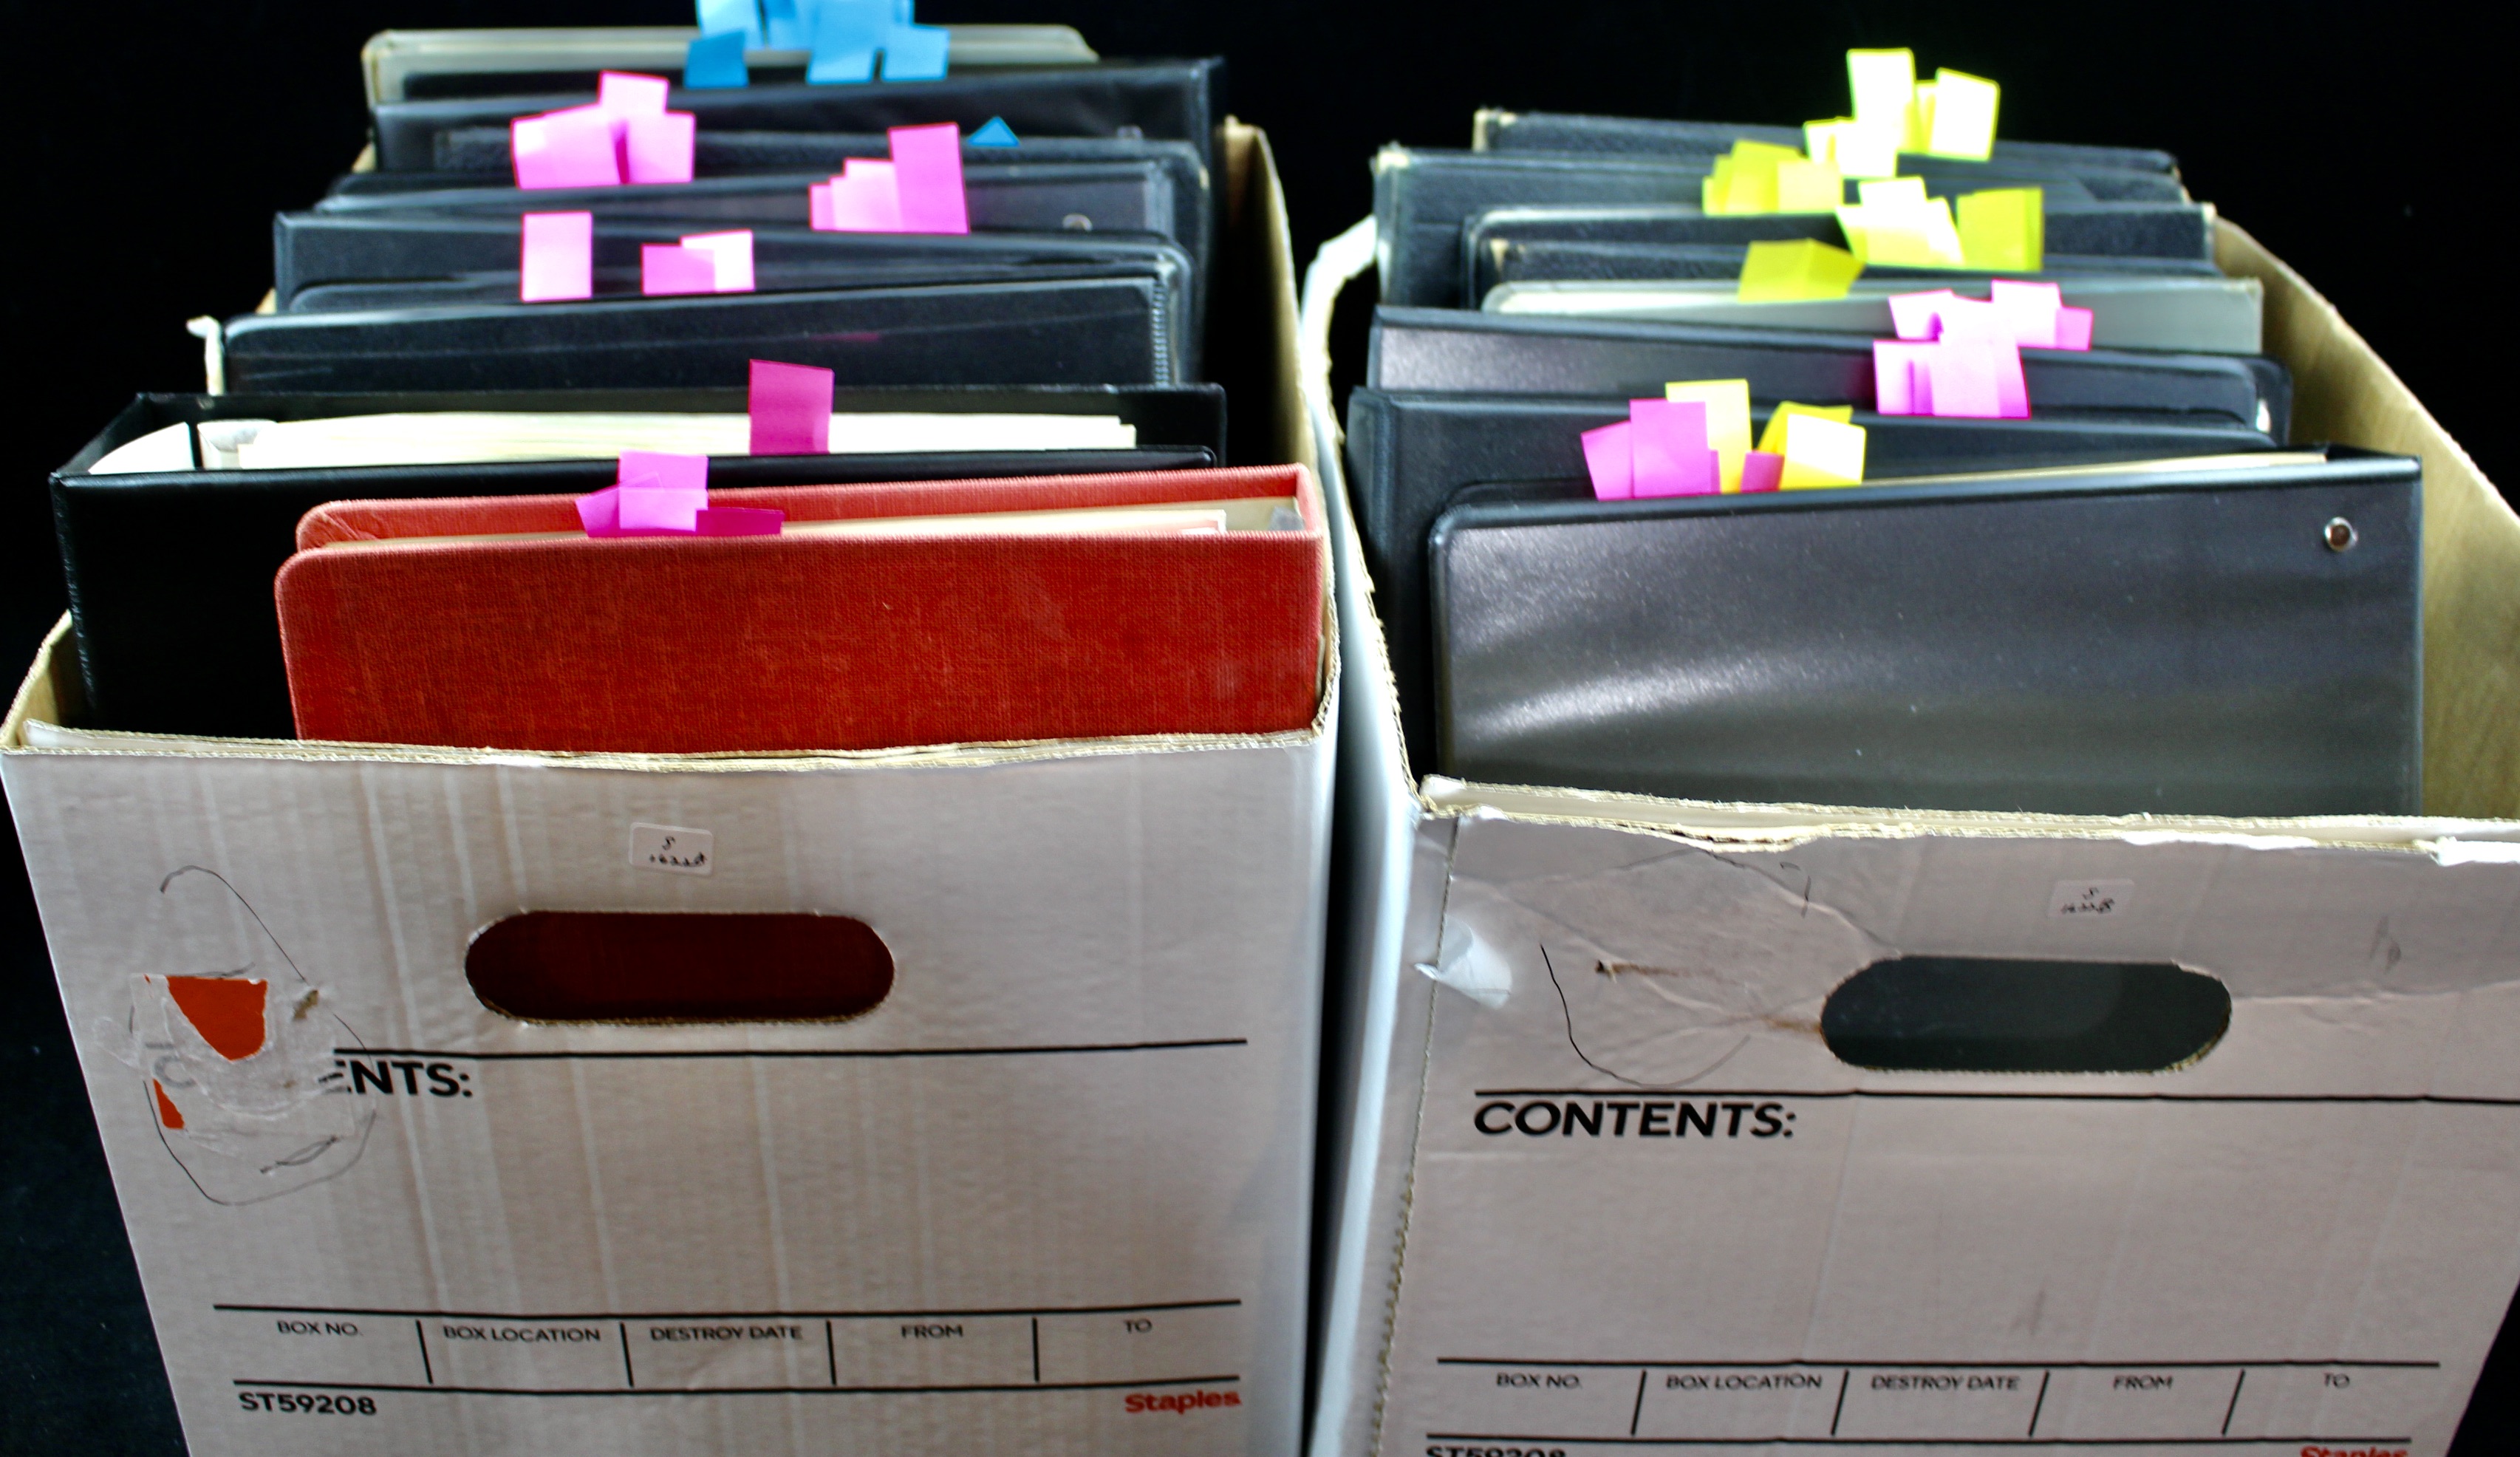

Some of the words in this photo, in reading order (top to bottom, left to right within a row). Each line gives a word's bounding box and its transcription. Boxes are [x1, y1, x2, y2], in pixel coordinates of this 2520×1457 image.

[1474, 1101, 1797, 1138] CONTENTS:
[277, 1321, 321, 1336] BOX
[443, 1325, 487, 1340] BOX
[492, 1328, 601, 1343] LOCATION
[650, 1325, 743, 1341] DESTROY
[748, 1324, 802, 1340] DATE
[901, 1323, 964, 1340] FROM
[1124, 1318, 1153, 1333] TO
[1495, 1373, 1540, 1388] BOX
[1666, 1374, 1710, 1390] BOX
[1715, 1373, 1823, 1391] LOCATION
[1870, 1375, 1963, 1391] DESTROY
[1967, 1375, 2021, 1391] DATE
[2113, 1375, 2174, 1391] FROM
[2323, 1373, 2351, 1388] TO
[239, 1392, 378, 1416] ST59208
[1124, 1389, 1242, 1415] Staples
